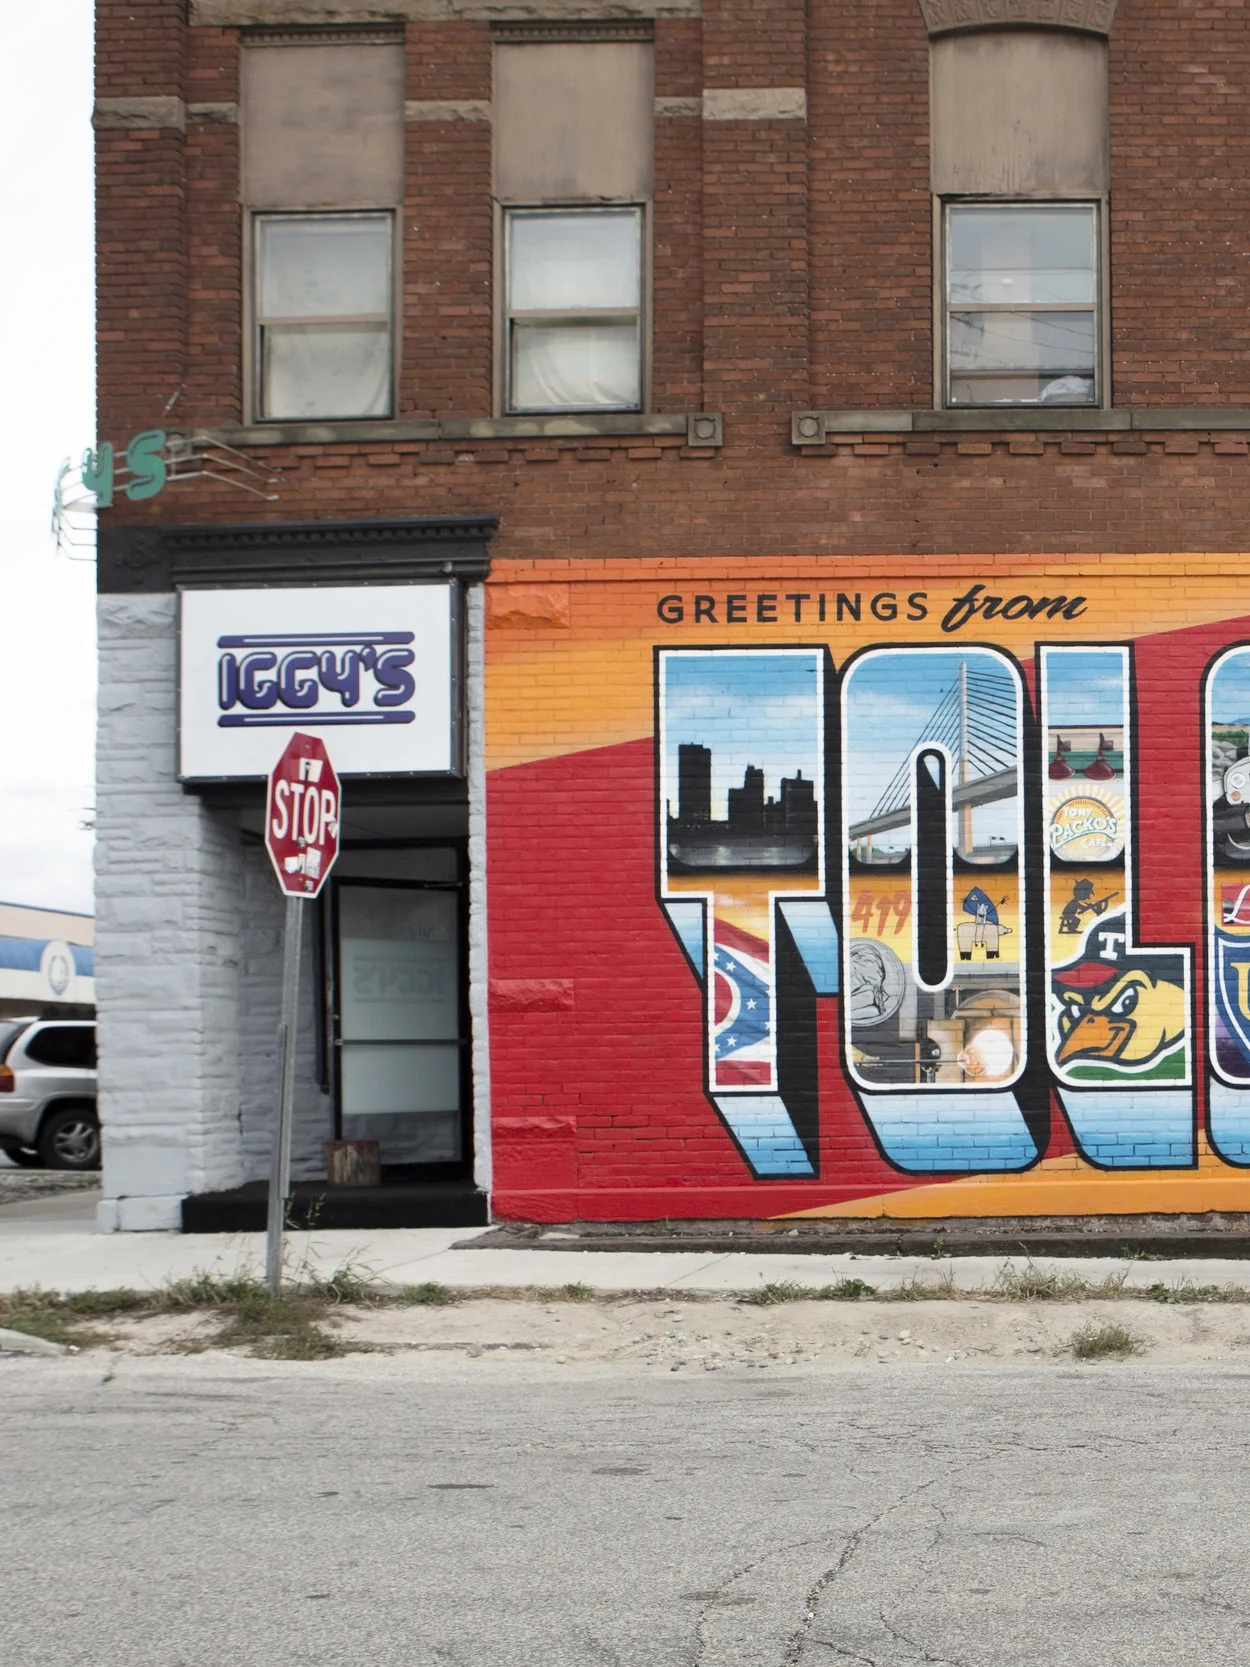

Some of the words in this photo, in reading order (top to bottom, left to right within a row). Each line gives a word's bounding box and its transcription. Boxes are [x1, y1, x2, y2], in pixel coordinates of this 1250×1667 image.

[657, 592, 928, 624] GREETINGS
[941, 584, 1088, 632] from
[217, 645, 415, 710] IGGY'S
[272, 779, 337, 845] STOP
[851, 890, 912, 936] 419
[1098, 931, 1125, 960] T
